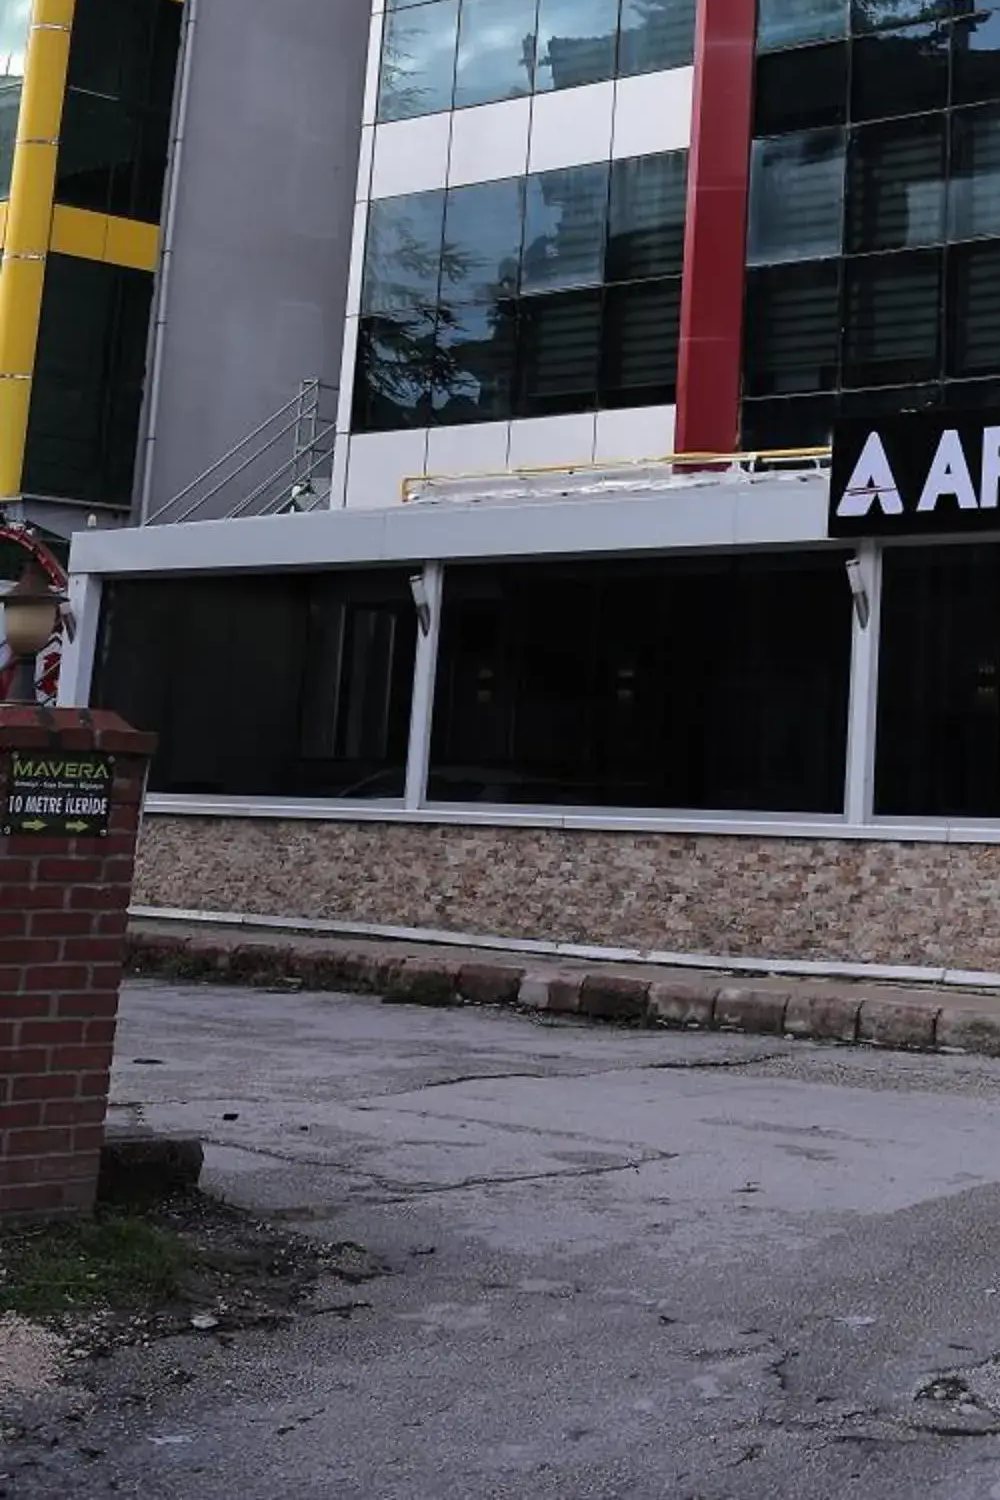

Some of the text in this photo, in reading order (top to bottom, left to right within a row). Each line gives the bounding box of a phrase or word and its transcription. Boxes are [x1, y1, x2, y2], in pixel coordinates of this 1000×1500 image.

[13, 760, 109, 779] MAVERA
[9, 795, 23, 813] 10
[24, 795, 63, 814] METRE
